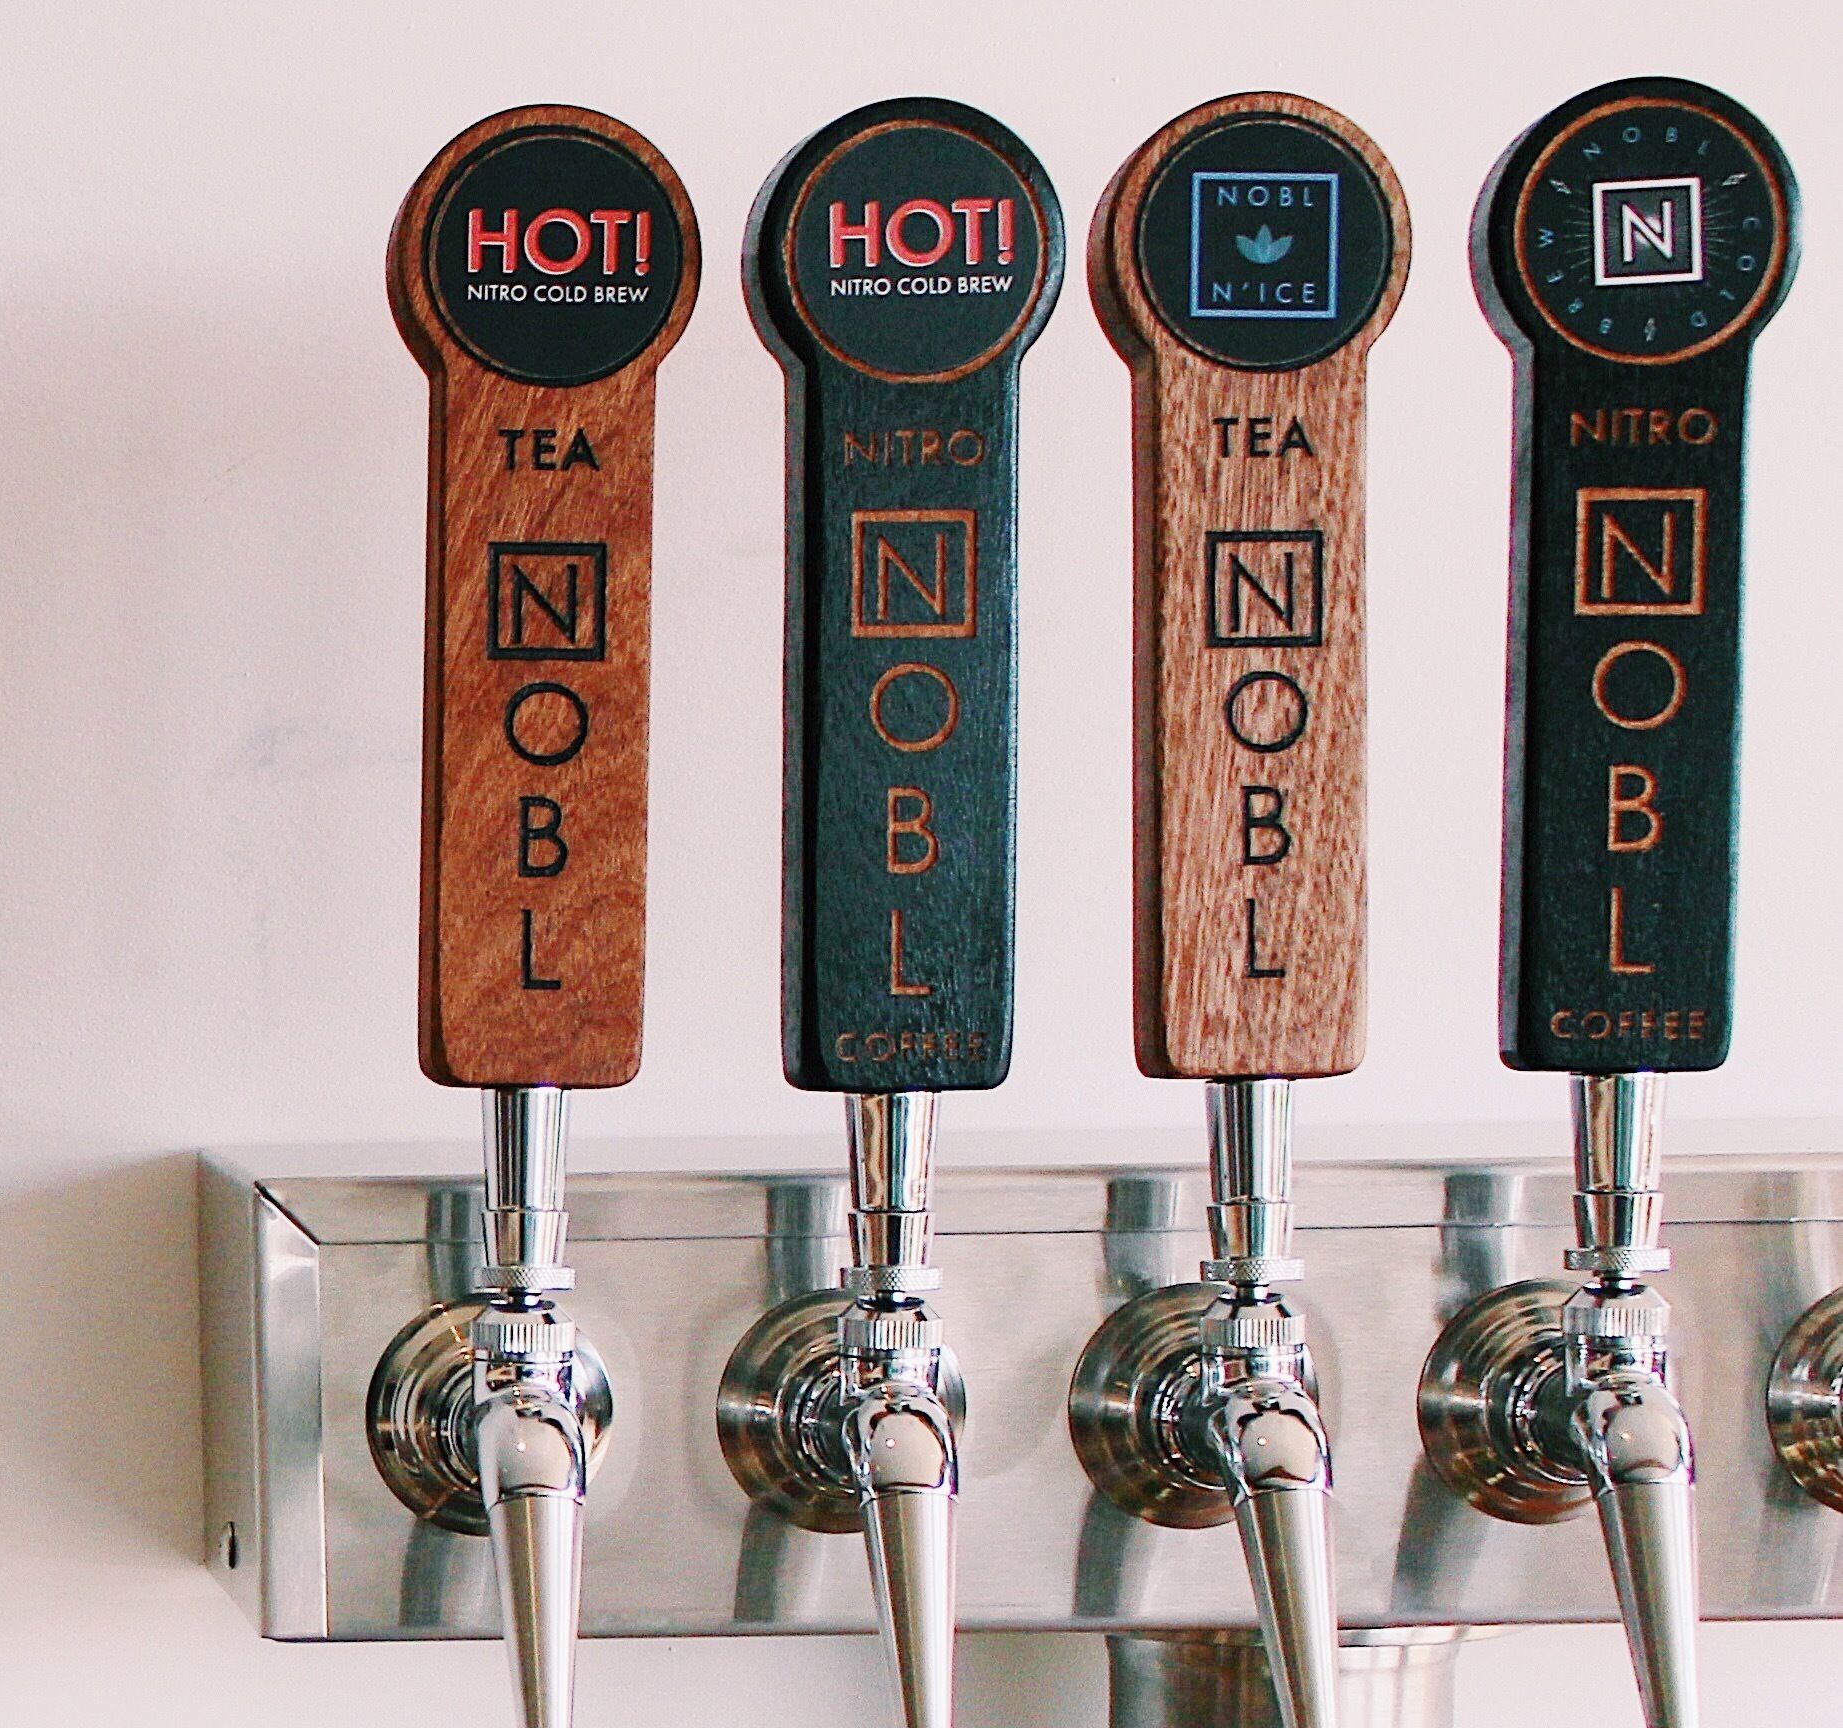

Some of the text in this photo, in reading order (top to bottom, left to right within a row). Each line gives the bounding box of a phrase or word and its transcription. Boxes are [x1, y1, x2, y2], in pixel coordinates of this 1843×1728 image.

[1217, 184, 1315, 208] NOBL
[467, 207, 651, 276] HOT!
[829, 197, 1015, 269] HOT!
[467, 283, 649, 304] NITRO COLD BREW
[830, 275, 1013, 297] NITRO COLD BREW
[844, 429, 986, 467] NITRO
[1212, 416, 1316, 459] TEA
[1569, 407, 1719, 447] NITRO
[498, 428, 600, 473] TEA
[851, 508, 977, 997] NOBL
[1575, 487, 1707, 976] NOBL
[487, 541, 606, 990] NOBL
[1204, 530, 1323, 979] NOBL
[1550, 1008, 1707, 1041] COFFEE
[834, 1031, 989, 1063] COFFEE
